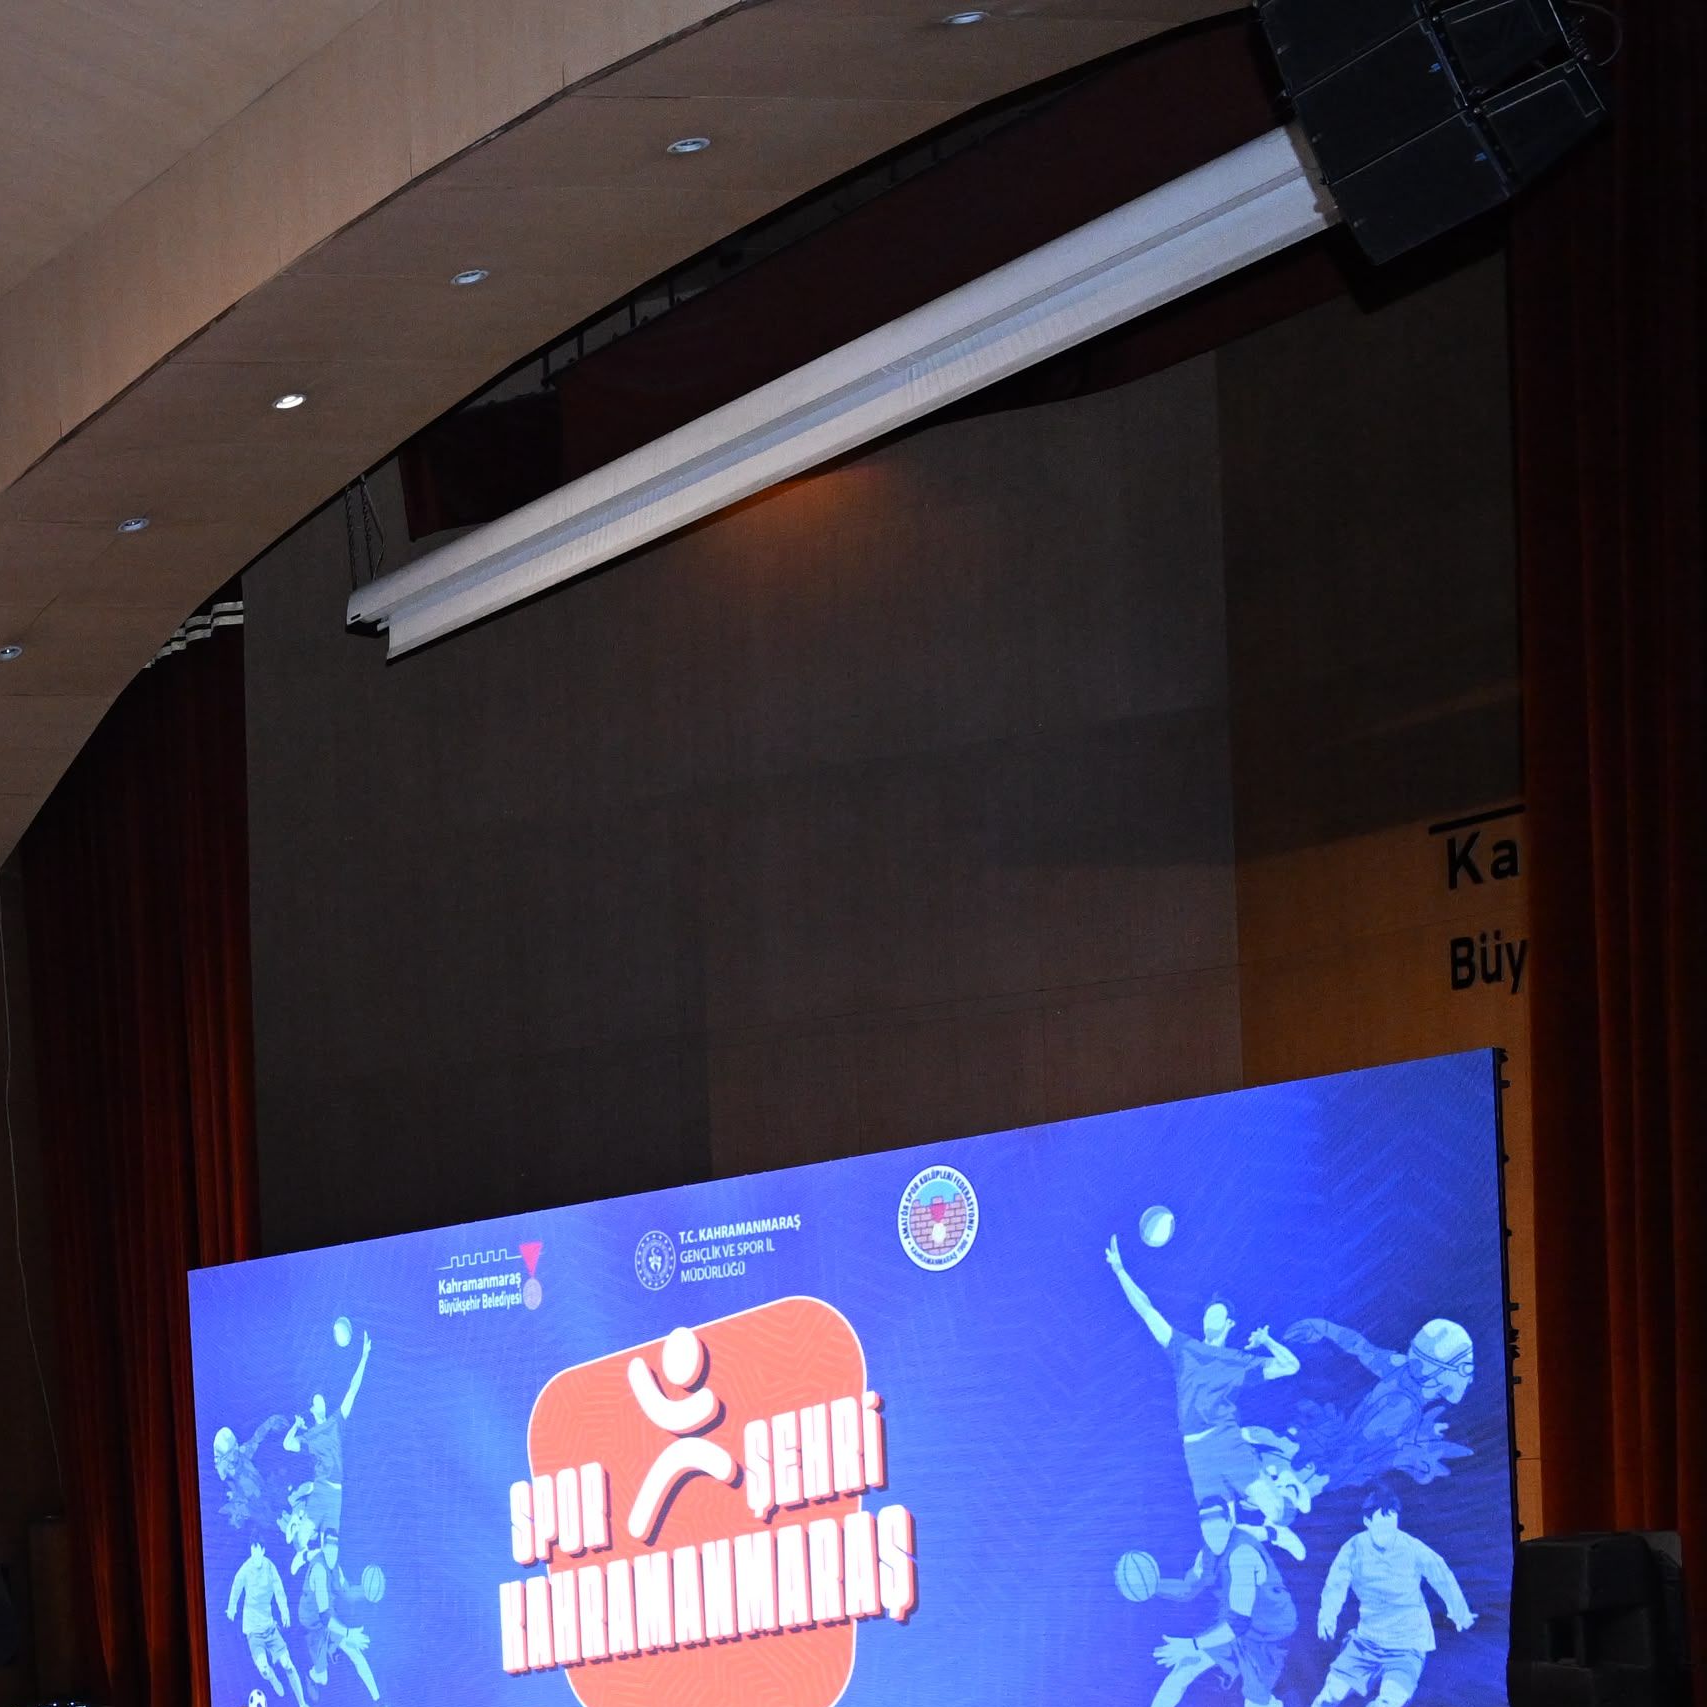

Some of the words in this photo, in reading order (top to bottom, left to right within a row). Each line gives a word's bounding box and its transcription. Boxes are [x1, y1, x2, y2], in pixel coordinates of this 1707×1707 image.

[905, 1181, 921, 1204] SPOR
[679, 1231, 698, 1245] T.C.
[699, 1214, 802, 1242] KAHRAMANMARAŞ
[680, 1244, 721, 1264] GENÇLİK
[722, 1245, 735, 1257] VE
[737, 1239, 764, 1256] SPOR
[766, 1237, 776, 1252] İL
[438, 1272, 522, 1296] Kahramanmaraş
[681, 1261, 746, 1283] MÜDÜRLÜĞÜ
[438, 1295, 481, 1317] Büyükşehir
[482, 1289, 522, 1310] Belediyesi
[509, 1462, 613, 1565] SPOR
[499, 1504, 917, 1674] KAHRAMANMARAŞ
